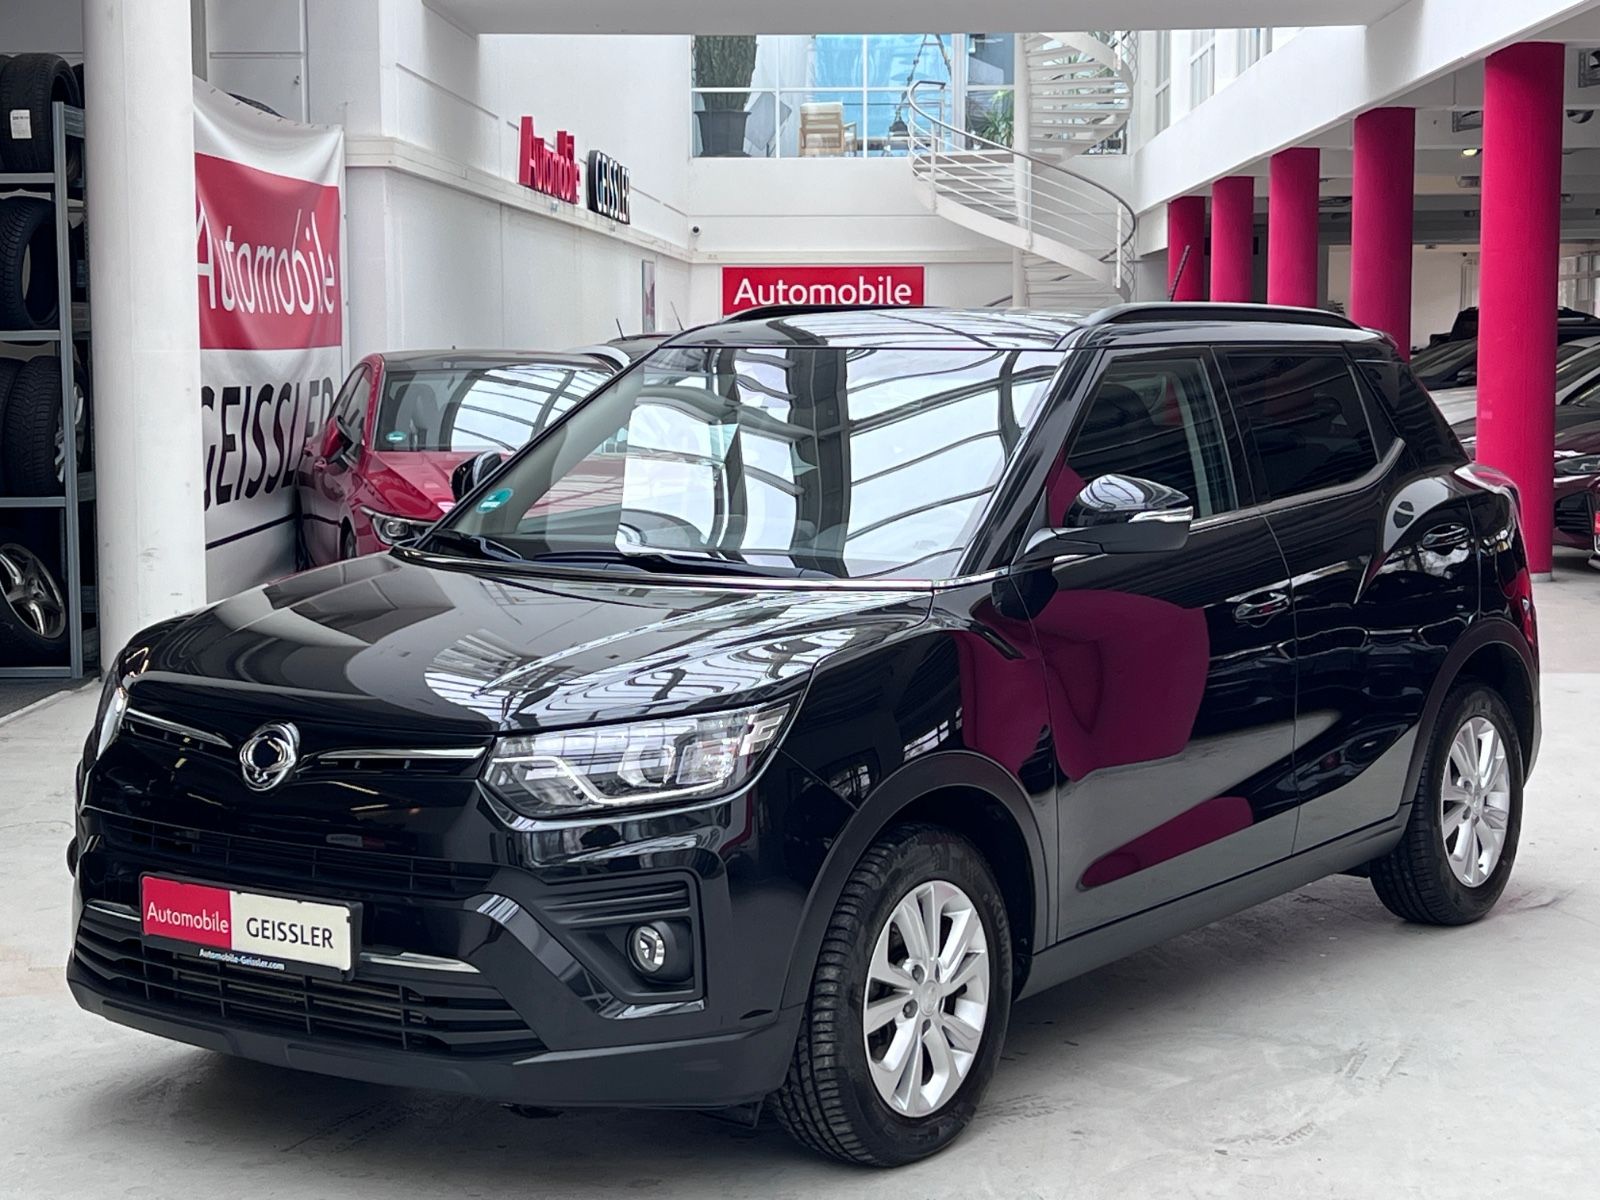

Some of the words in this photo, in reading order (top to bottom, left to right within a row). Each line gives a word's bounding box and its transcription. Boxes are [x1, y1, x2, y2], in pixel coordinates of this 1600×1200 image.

[197, 200, 335, 315] Automobile
[732, 275, 912, 306] Automobile
[146, 901, 229, 934] Automobile
[246, 917, 334, 949] GEISSLER
[199, 948, 285, 971] Automobile-Geissler.com
